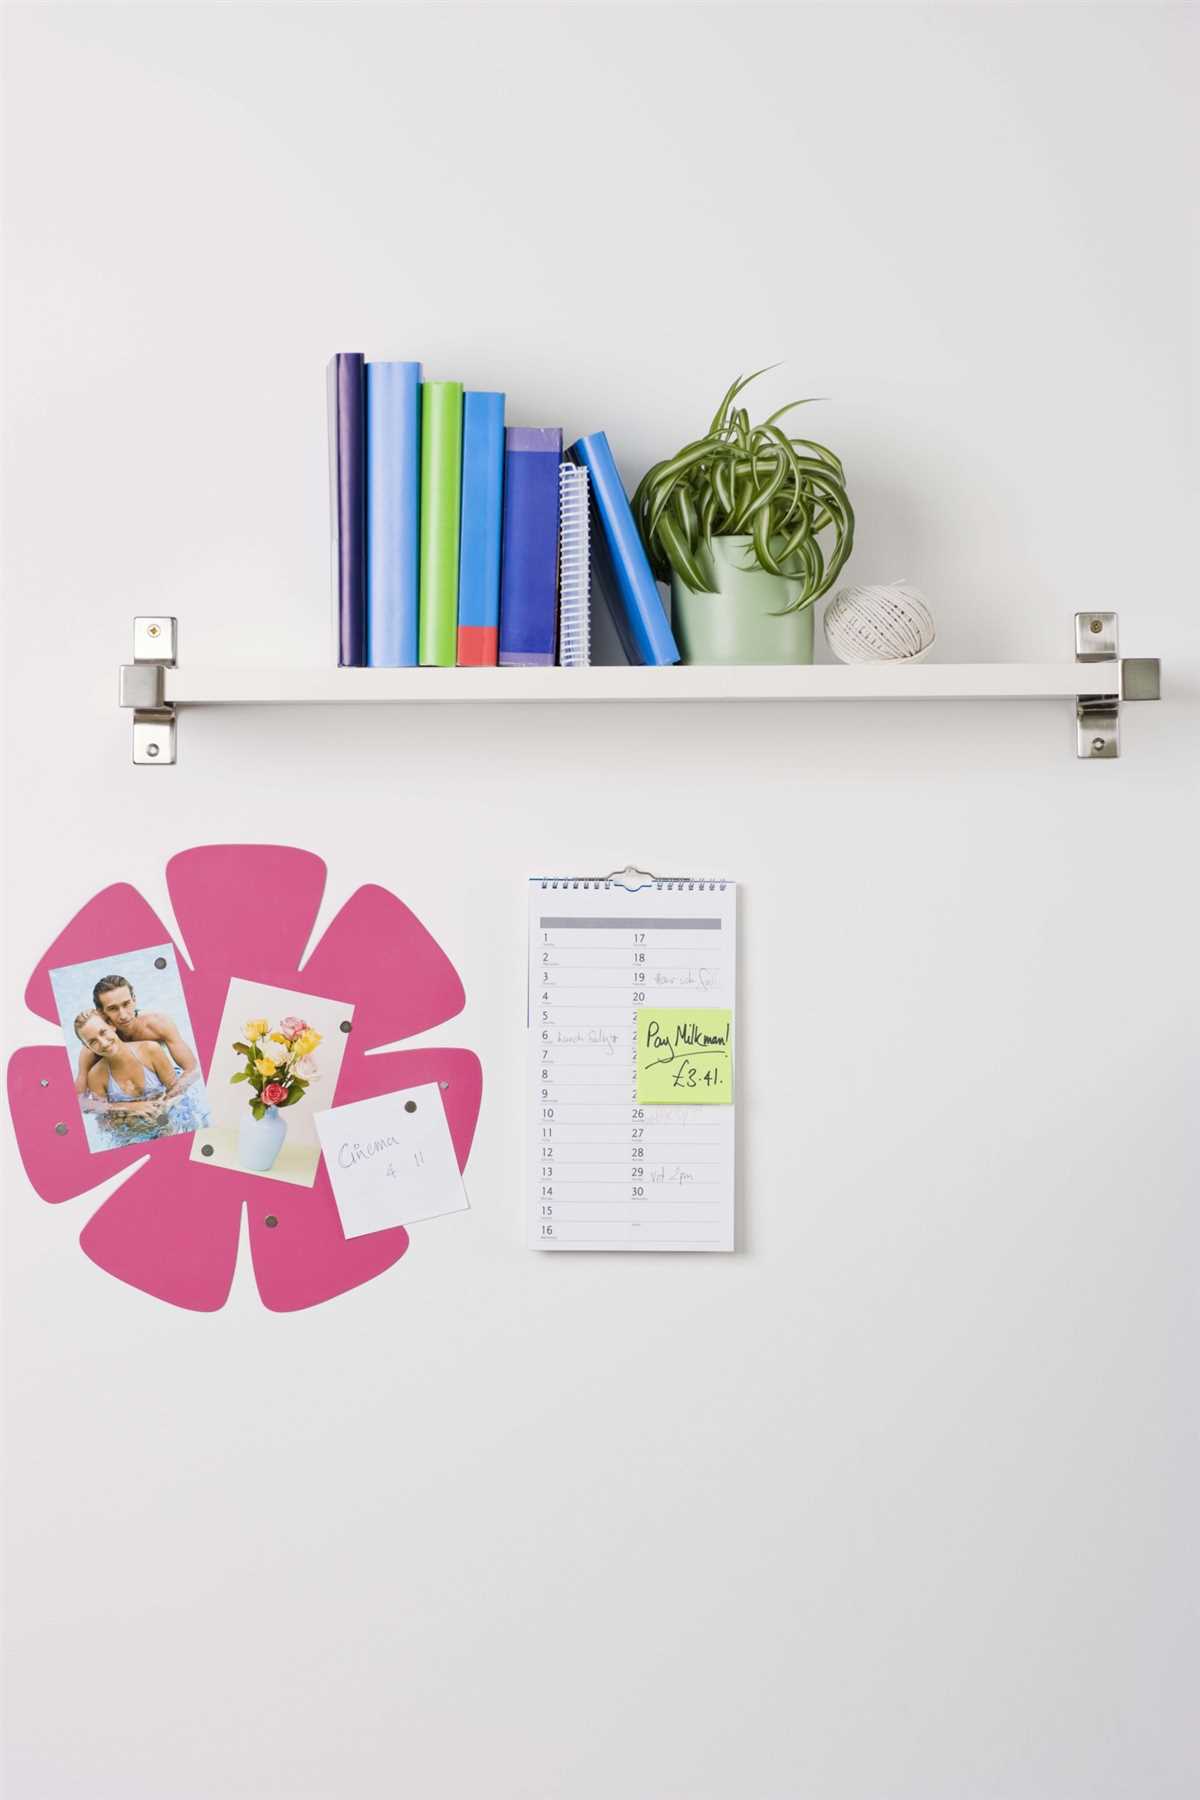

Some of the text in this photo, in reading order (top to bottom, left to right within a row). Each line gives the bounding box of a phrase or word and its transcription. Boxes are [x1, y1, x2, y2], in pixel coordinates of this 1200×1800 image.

[634, 933, 646, 943] 17
[542, 952, 549, 962] 2
[634, 953, 646, 962] 18
[543, 972, 549, 981] 3
[634, 973, 646, 982] 19
[542, 991, 549, 1001] 4
[632, 992, 646, 1001] 20
[542, 1011, 549, 1020] 5
[541, 1030, 549, 1040] 6
[645, 1021, 675, 1063] Pay
[675, 1023, 729, 1057] Milkman!
[542, 1049, 549, 1059] 7
[541, 1069, 549, 1079] 8
[541, 1089, 549, 1098] 9
[543, 1108, 554, 1118] 10
[631, 1109, 645, 1118] 26
[543, 1127, 552, 1137] 11
[631, 1128, 644, 1138] 27
[542, 1148, 553, 1157] 12
[631, 1148, 645, 1157] 28
[542, 1167, 553, 1176] 13
[631, 1167, 644, 1177] 29
[542, 1186, 553, 1196] 14
[632, 1187, 645, 1196] 30
[542, 1206, 553, 1215] 15
[542, 1226, 553, 1235] 16
